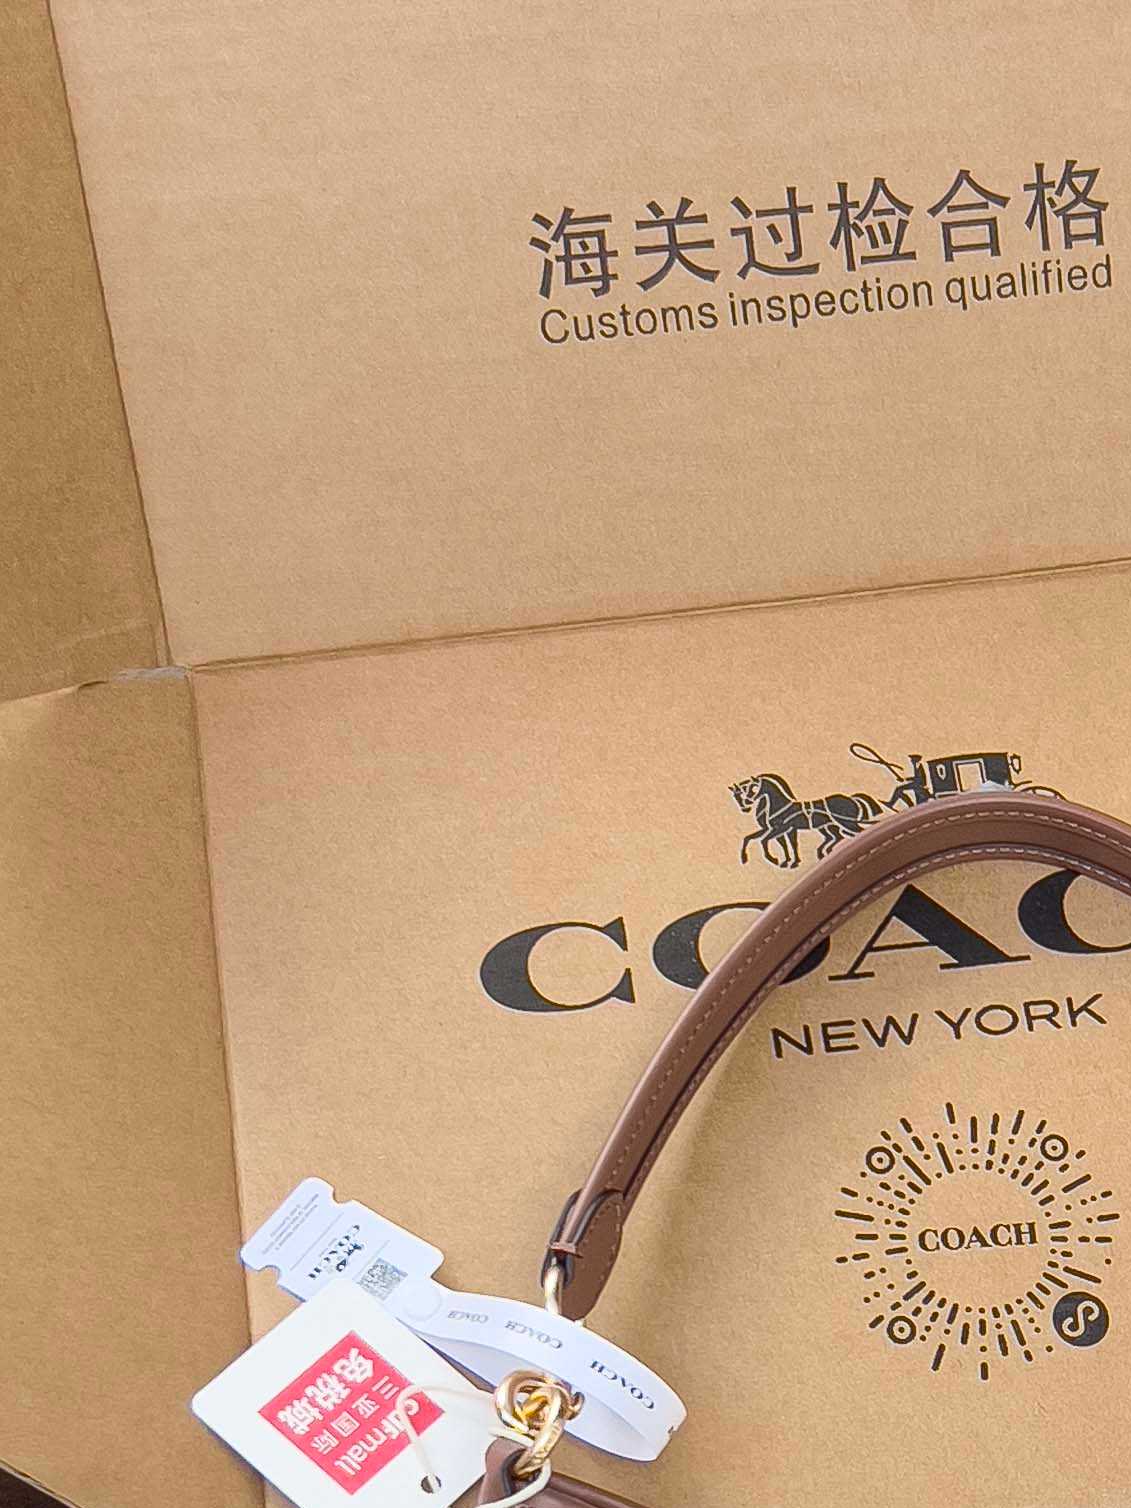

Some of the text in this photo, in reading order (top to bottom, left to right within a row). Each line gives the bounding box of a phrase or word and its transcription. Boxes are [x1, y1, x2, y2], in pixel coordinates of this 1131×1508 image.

[528, 159, 1110, 300] 海关过检合格
[541, 255, 1112, 344] Customs inspection qualified
[771, 993, 1109, 1059] NEW YORK
[918, 1222, 1038, 1251] COACH
[448, 1310, 489, 1325] COACH
[505, 1320, 563, 1350] COACH
[277, 1348, 374, 1435] 免税城
[311, 1376, 400, 1455] 三亚国际
[590, 1360, 655, 1410] COACH
